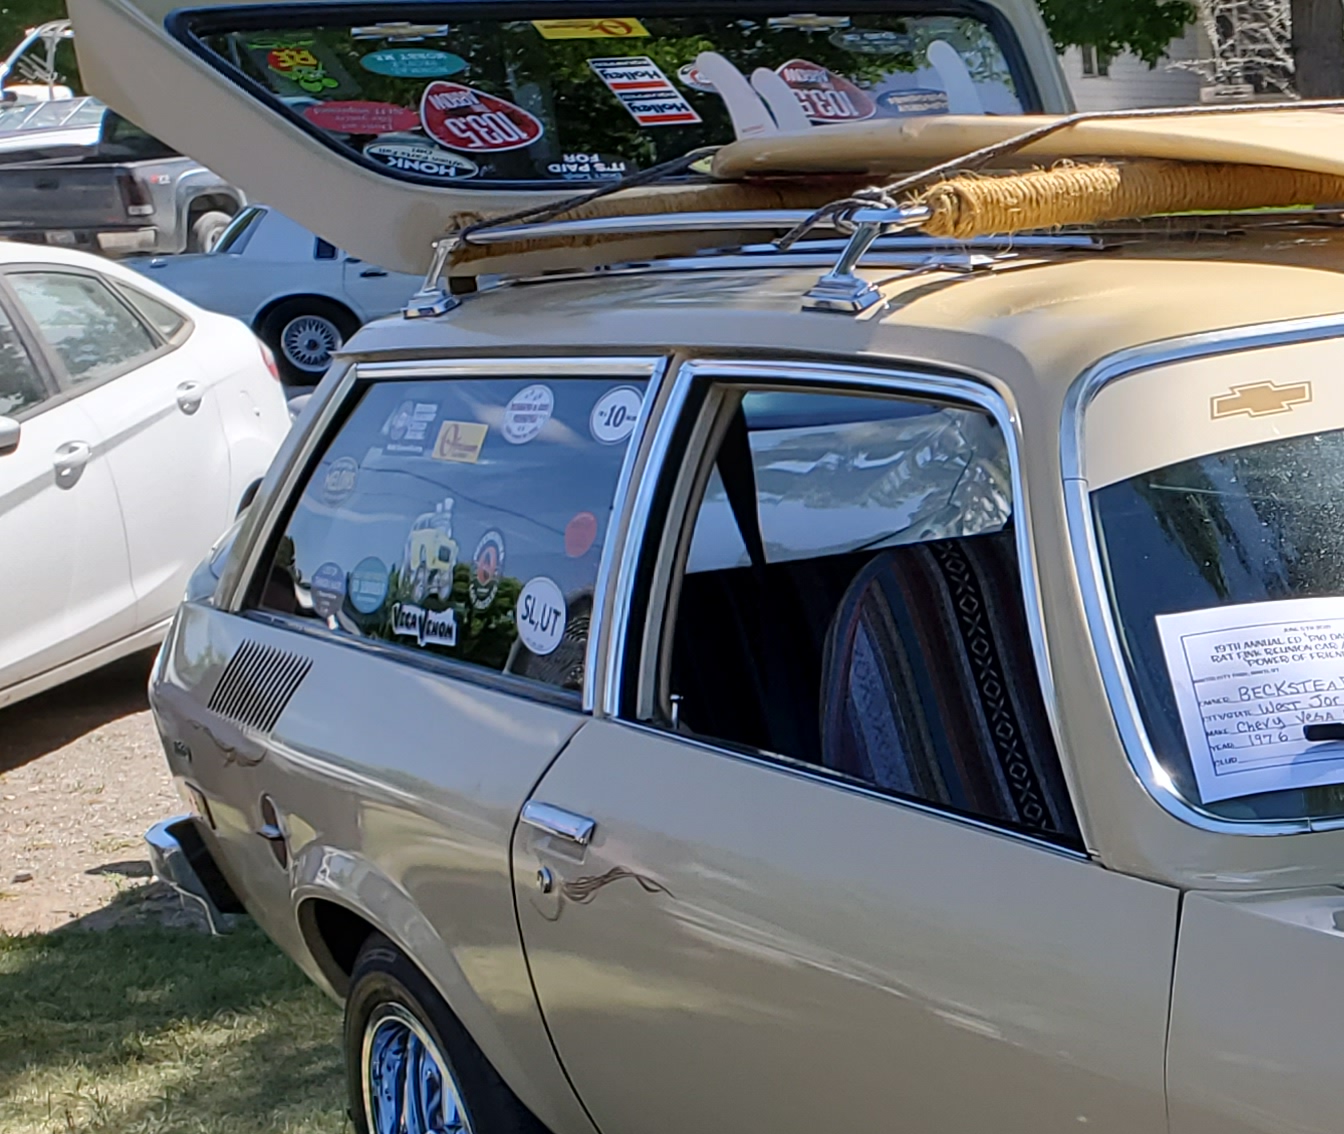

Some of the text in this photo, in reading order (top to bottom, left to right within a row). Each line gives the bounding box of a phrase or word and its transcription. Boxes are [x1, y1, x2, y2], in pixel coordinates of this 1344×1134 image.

[599, 69, 662, 81] Holley
[627, 102, 690, 114] Holley
[443, 111, 530, 148] 103.5
[386, 156, 457, 177] HONK
[563, 153, 600, 164] FOR
[547, 162, 626, 173] IT'S PAID
[604, 404, 627, 428] 10
[393, 603, 455, 641] VEGA VENOM
[520, 593, 562, 638] SL,UT
[1210, 653, 1234, 664] RAT
[1236, 650, 1262, 661] FINK
[1263, 645, 1312, 657] REUNION
[1314, 641, 1338, 651] CAR
[1213, 641, 1241, 654] 19TH
[1244, 637, 1286, 650] ANNUAL
[1291, 653, 1307, 662] OF
[1236, 717, 1287, 734] Chevy
[1248, 731, 1289, 747] 1976
